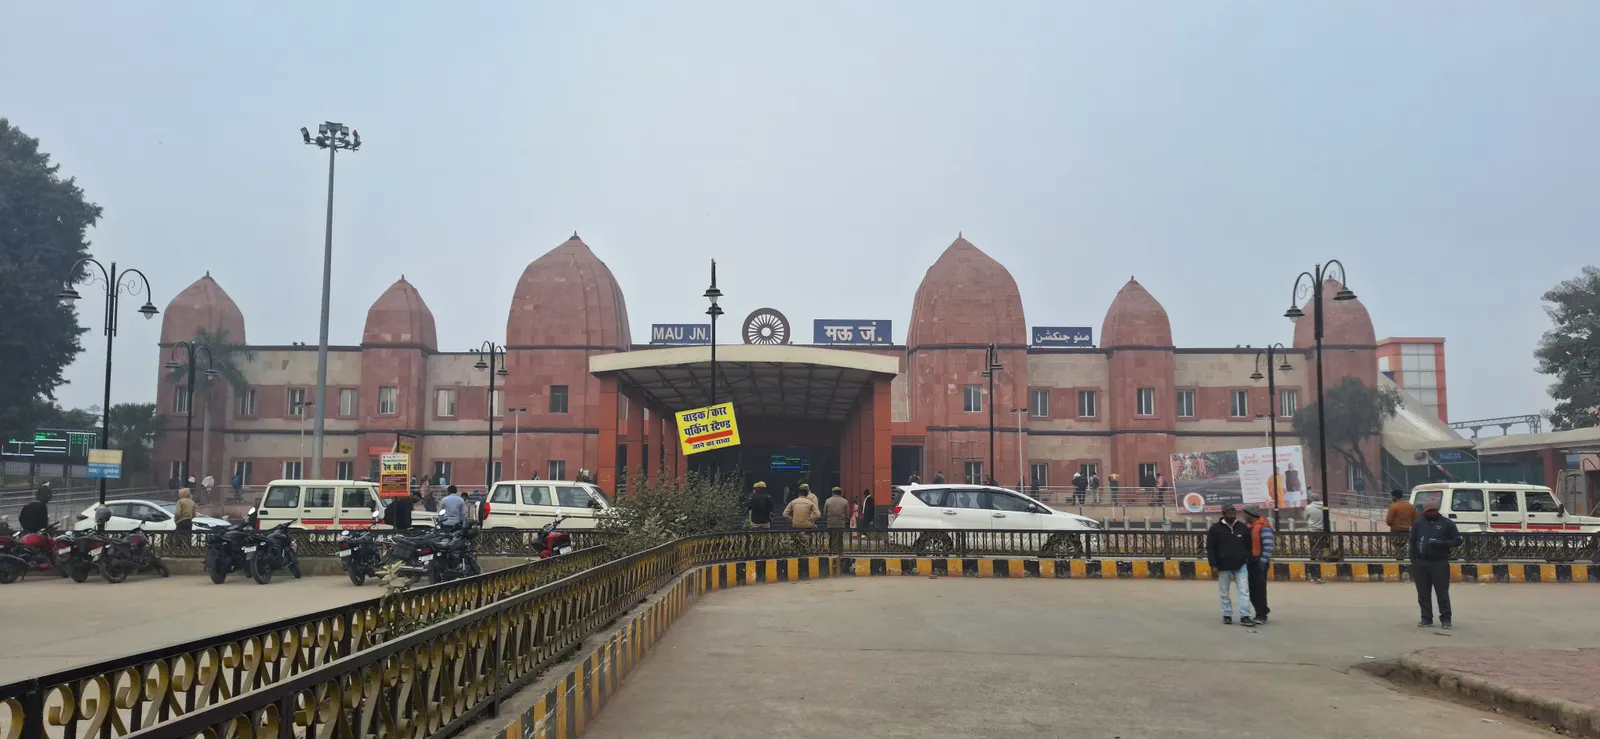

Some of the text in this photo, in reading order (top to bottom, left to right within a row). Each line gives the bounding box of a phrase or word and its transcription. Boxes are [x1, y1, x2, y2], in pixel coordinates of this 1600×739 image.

[653, 326, 709, 341] MAU JN.
[823, 321, 883, 342] मऊ जं.
